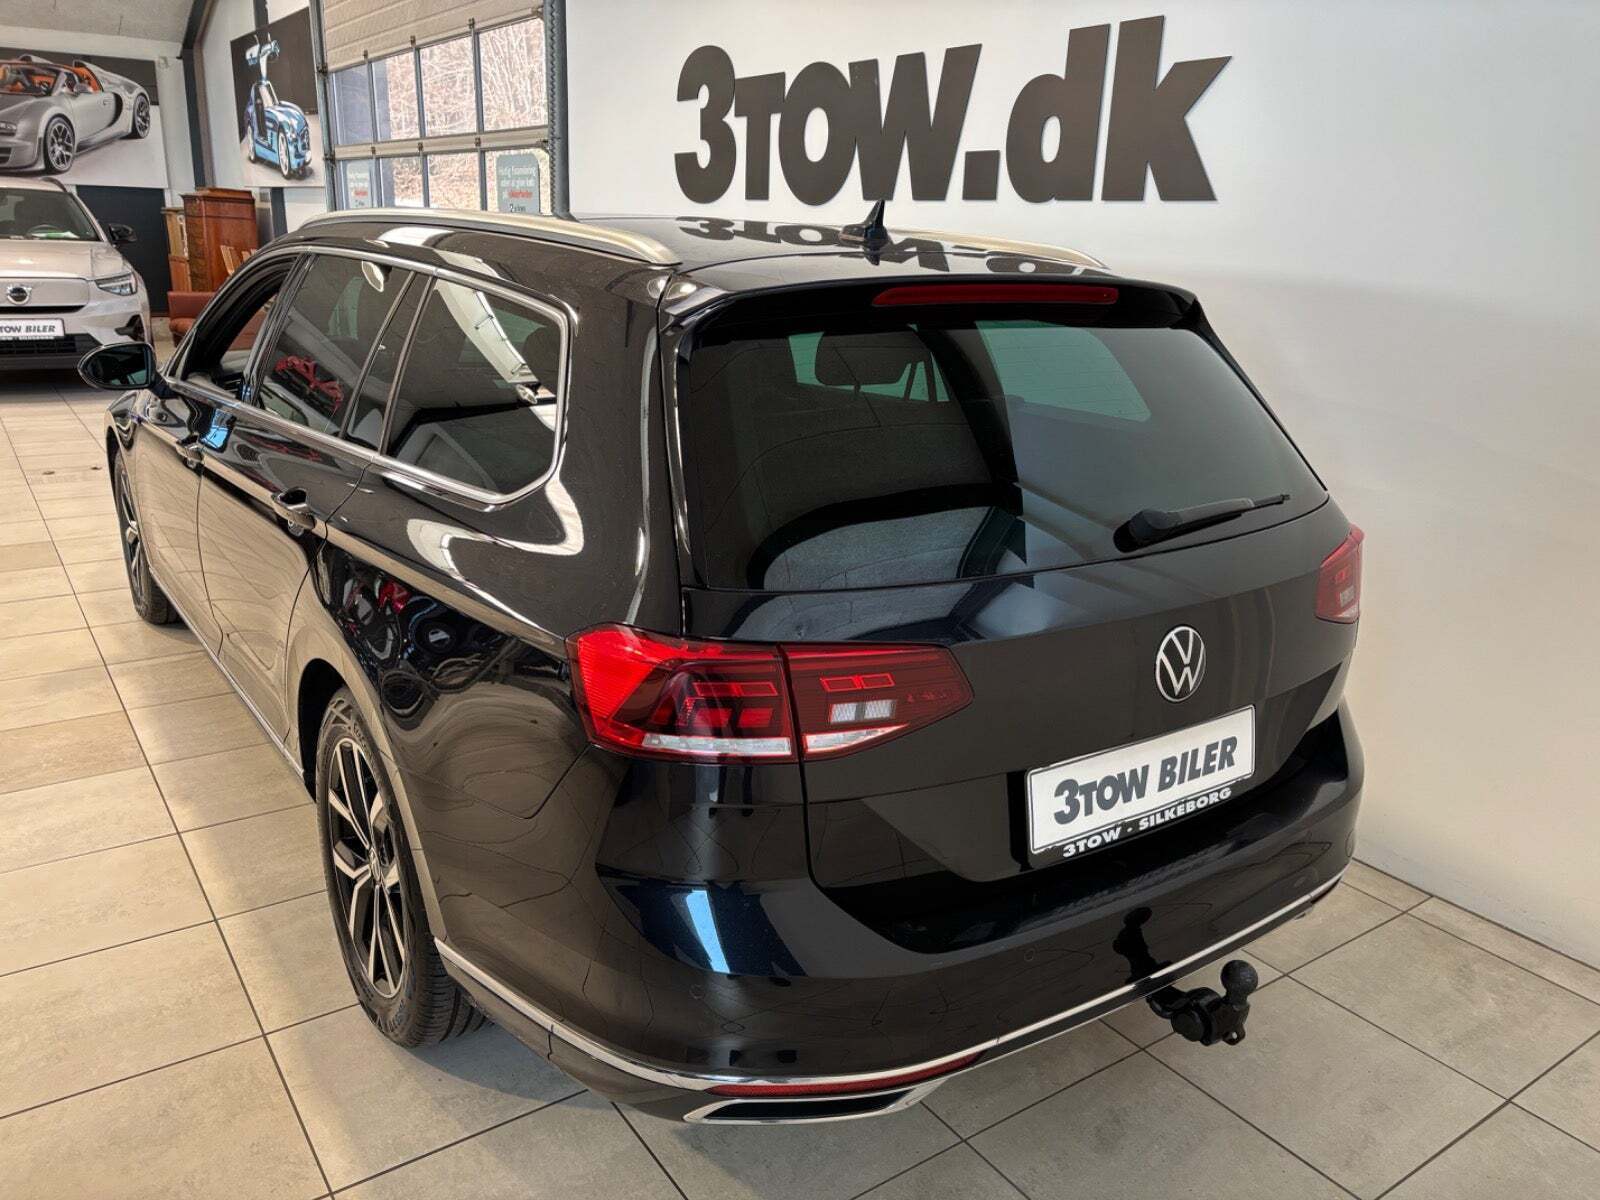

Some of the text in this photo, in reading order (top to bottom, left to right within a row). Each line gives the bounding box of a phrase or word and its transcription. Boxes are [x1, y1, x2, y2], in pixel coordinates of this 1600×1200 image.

[674, 15, 1232, 206] 3TOW.dk
[25, 325, 56, 333] BILER
[1053, 736, 1238, 825] 3TOW BILER
[1062, 827, 1122, 858] 3TOW
[1139, 787, 1232, 831] SILKEBORG
